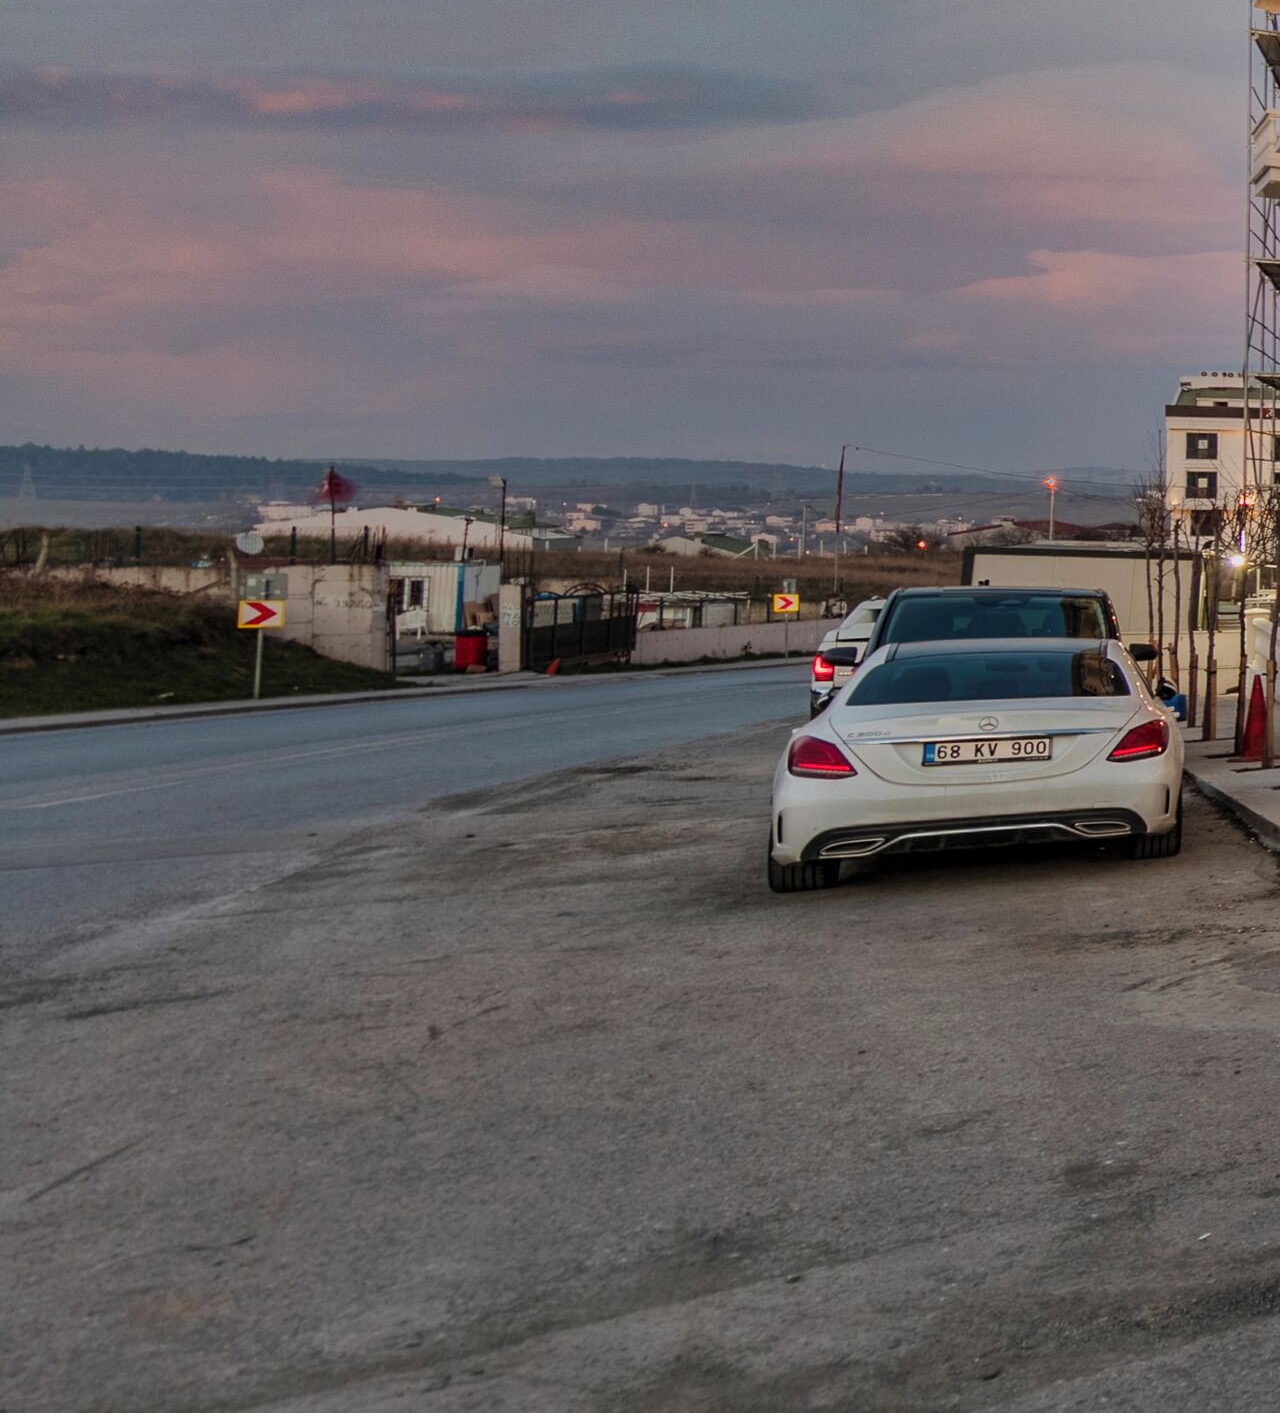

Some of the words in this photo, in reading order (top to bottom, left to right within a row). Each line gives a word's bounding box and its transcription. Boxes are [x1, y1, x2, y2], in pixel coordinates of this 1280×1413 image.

[937, 744, 960, 759] 68
[974, 743, 998, 757] KV
[1011, 741, 1047, 755] 900
